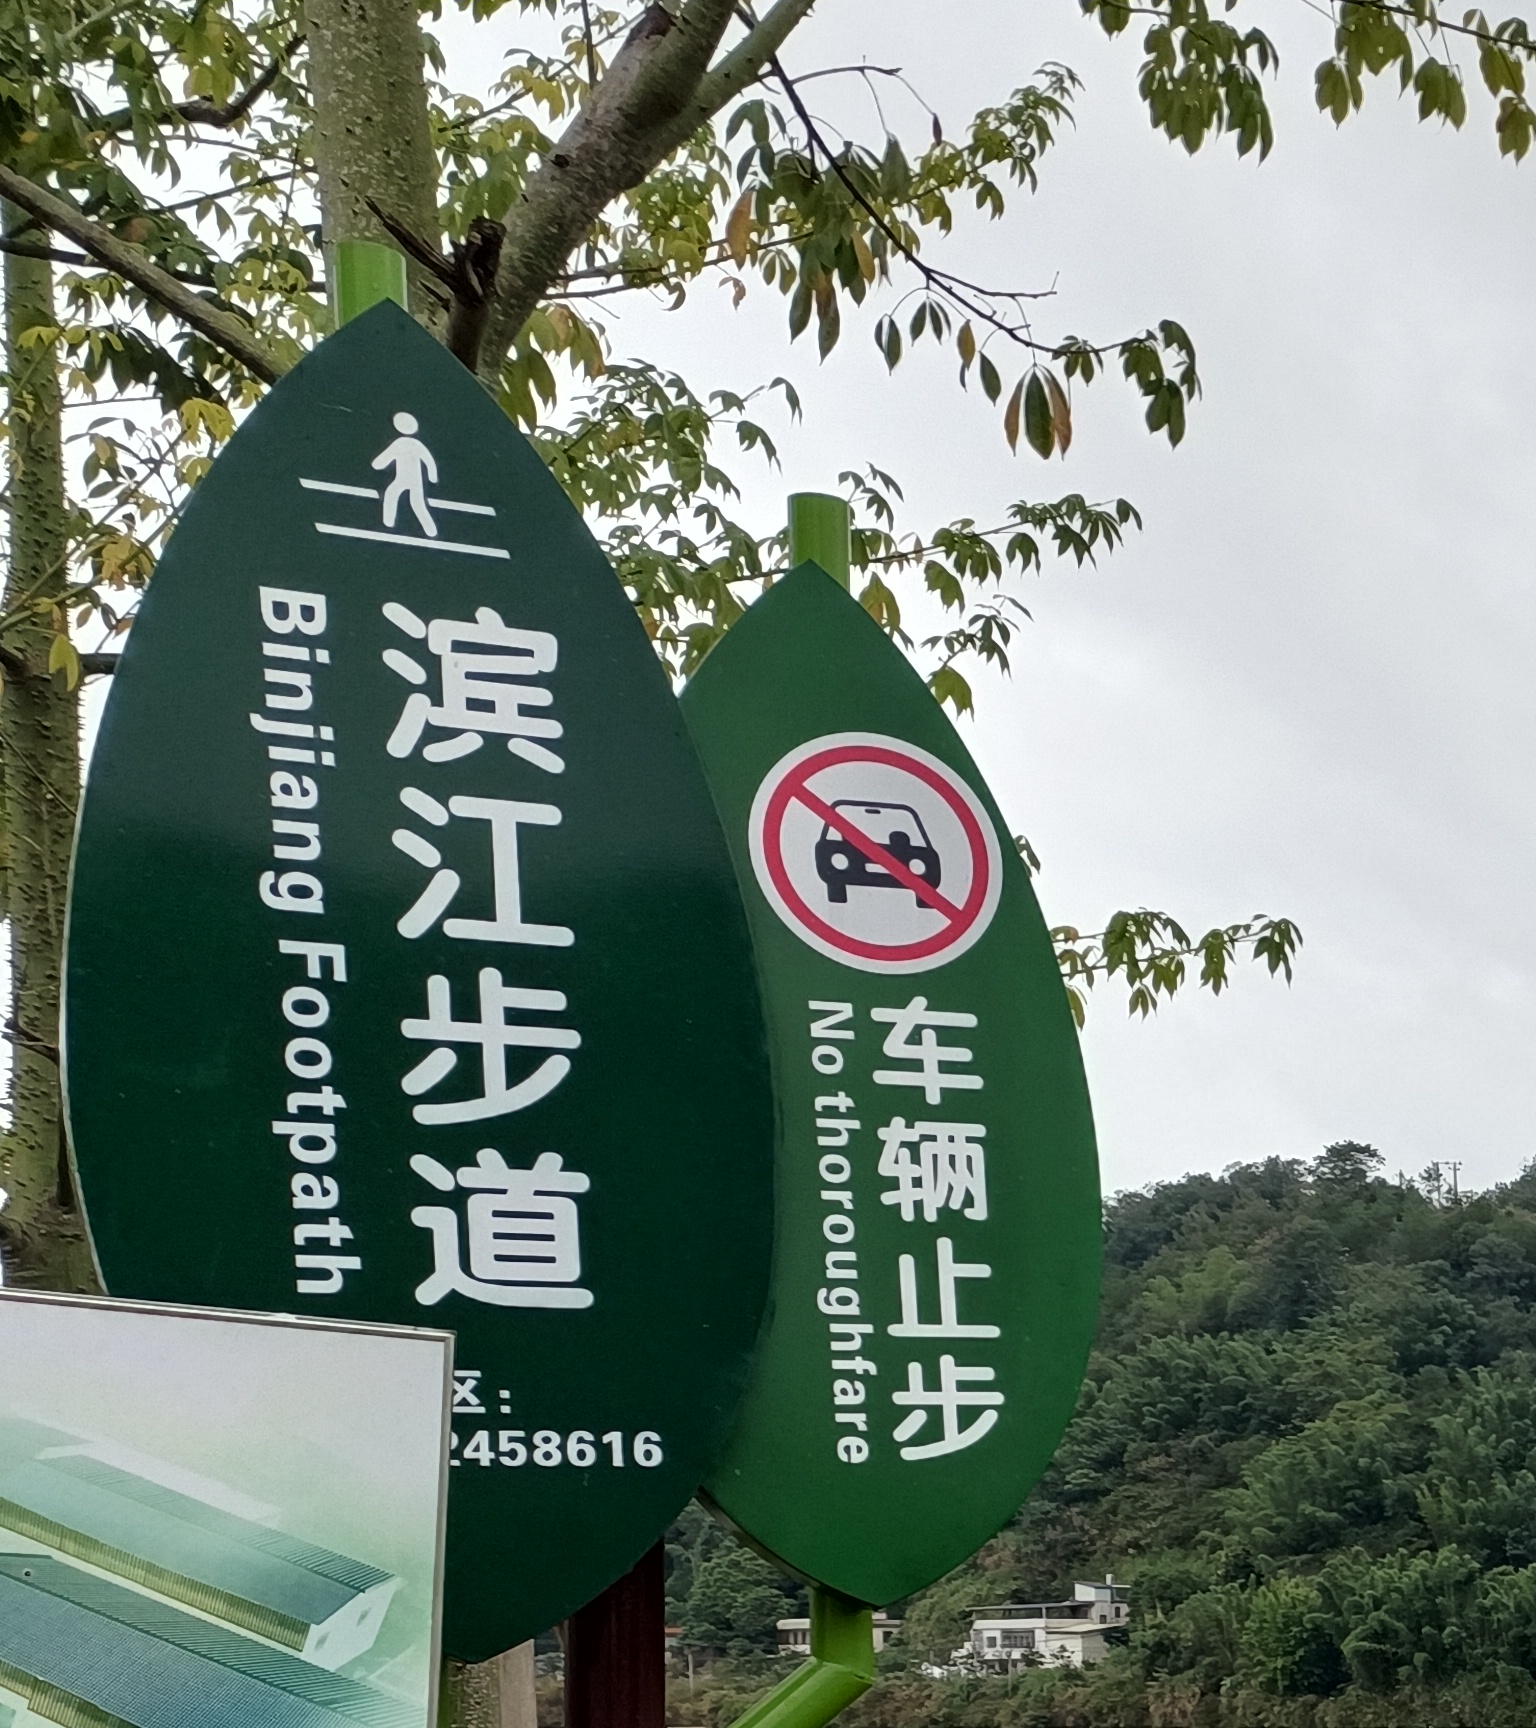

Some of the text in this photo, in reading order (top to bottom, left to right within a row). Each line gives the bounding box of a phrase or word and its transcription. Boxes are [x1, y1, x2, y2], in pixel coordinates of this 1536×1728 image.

[250, 585, 362, 1294] Binjiang Footpath
[382, 602, 594, 1309] 滨江步道
[808, 1000, 877, 1465] No thoroughfare
[870, 996, 1005, 1462] 车辆止步
